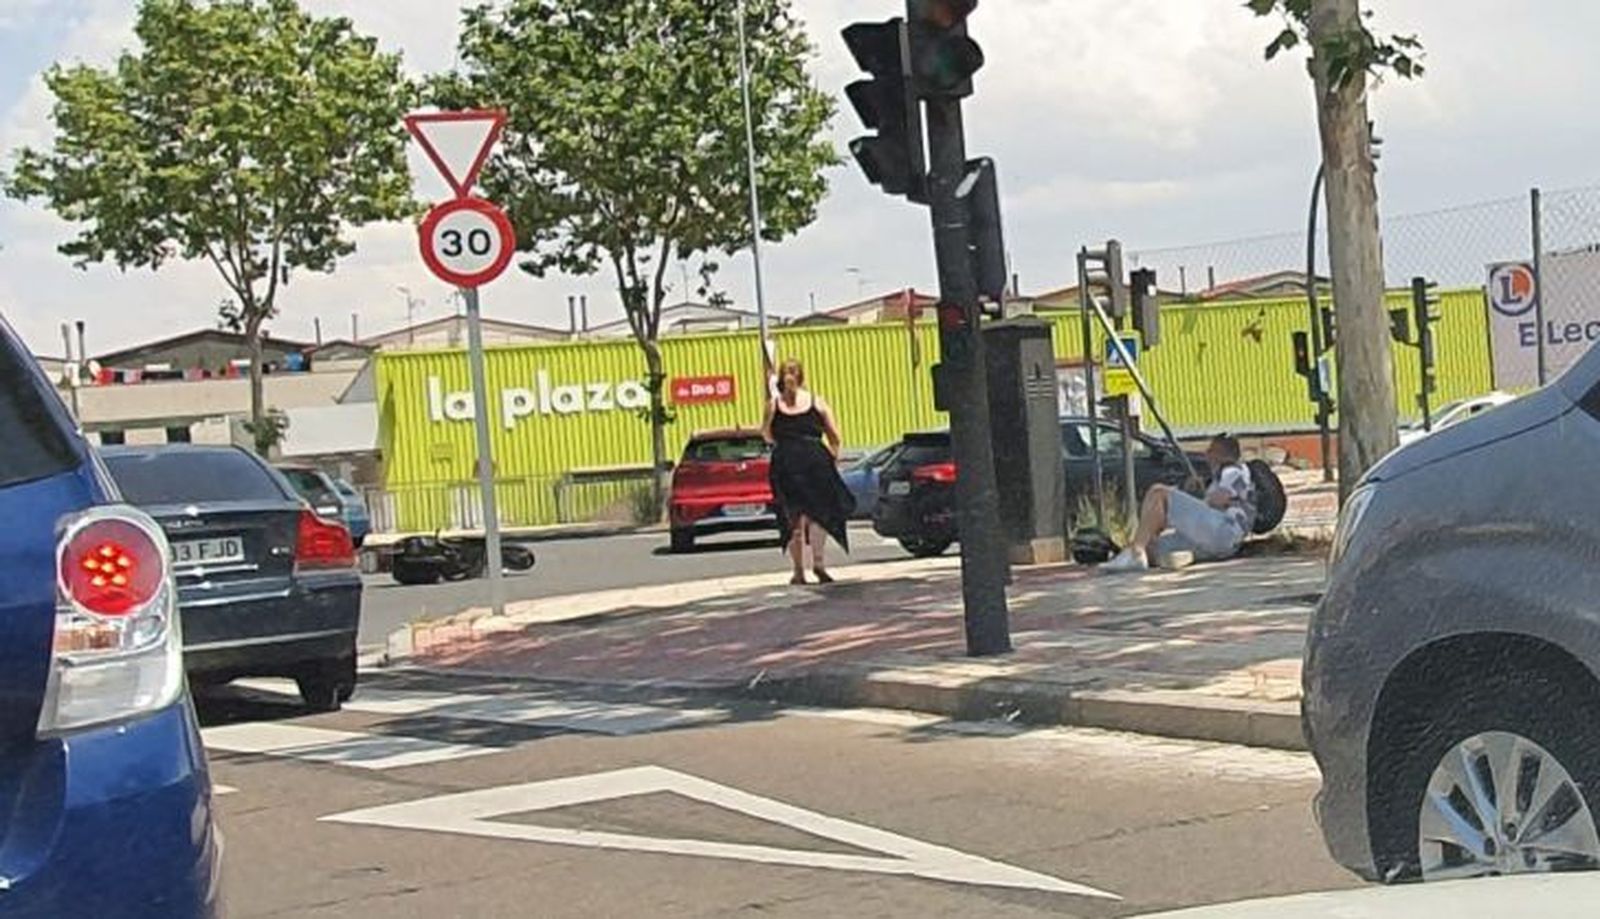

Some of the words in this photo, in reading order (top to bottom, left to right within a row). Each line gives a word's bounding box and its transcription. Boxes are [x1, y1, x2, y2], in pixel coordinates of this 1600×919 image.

[441, 228, 491, 257] 30
[428, 375, 475, 421] la
[502, 369, 651, 431] plaza
